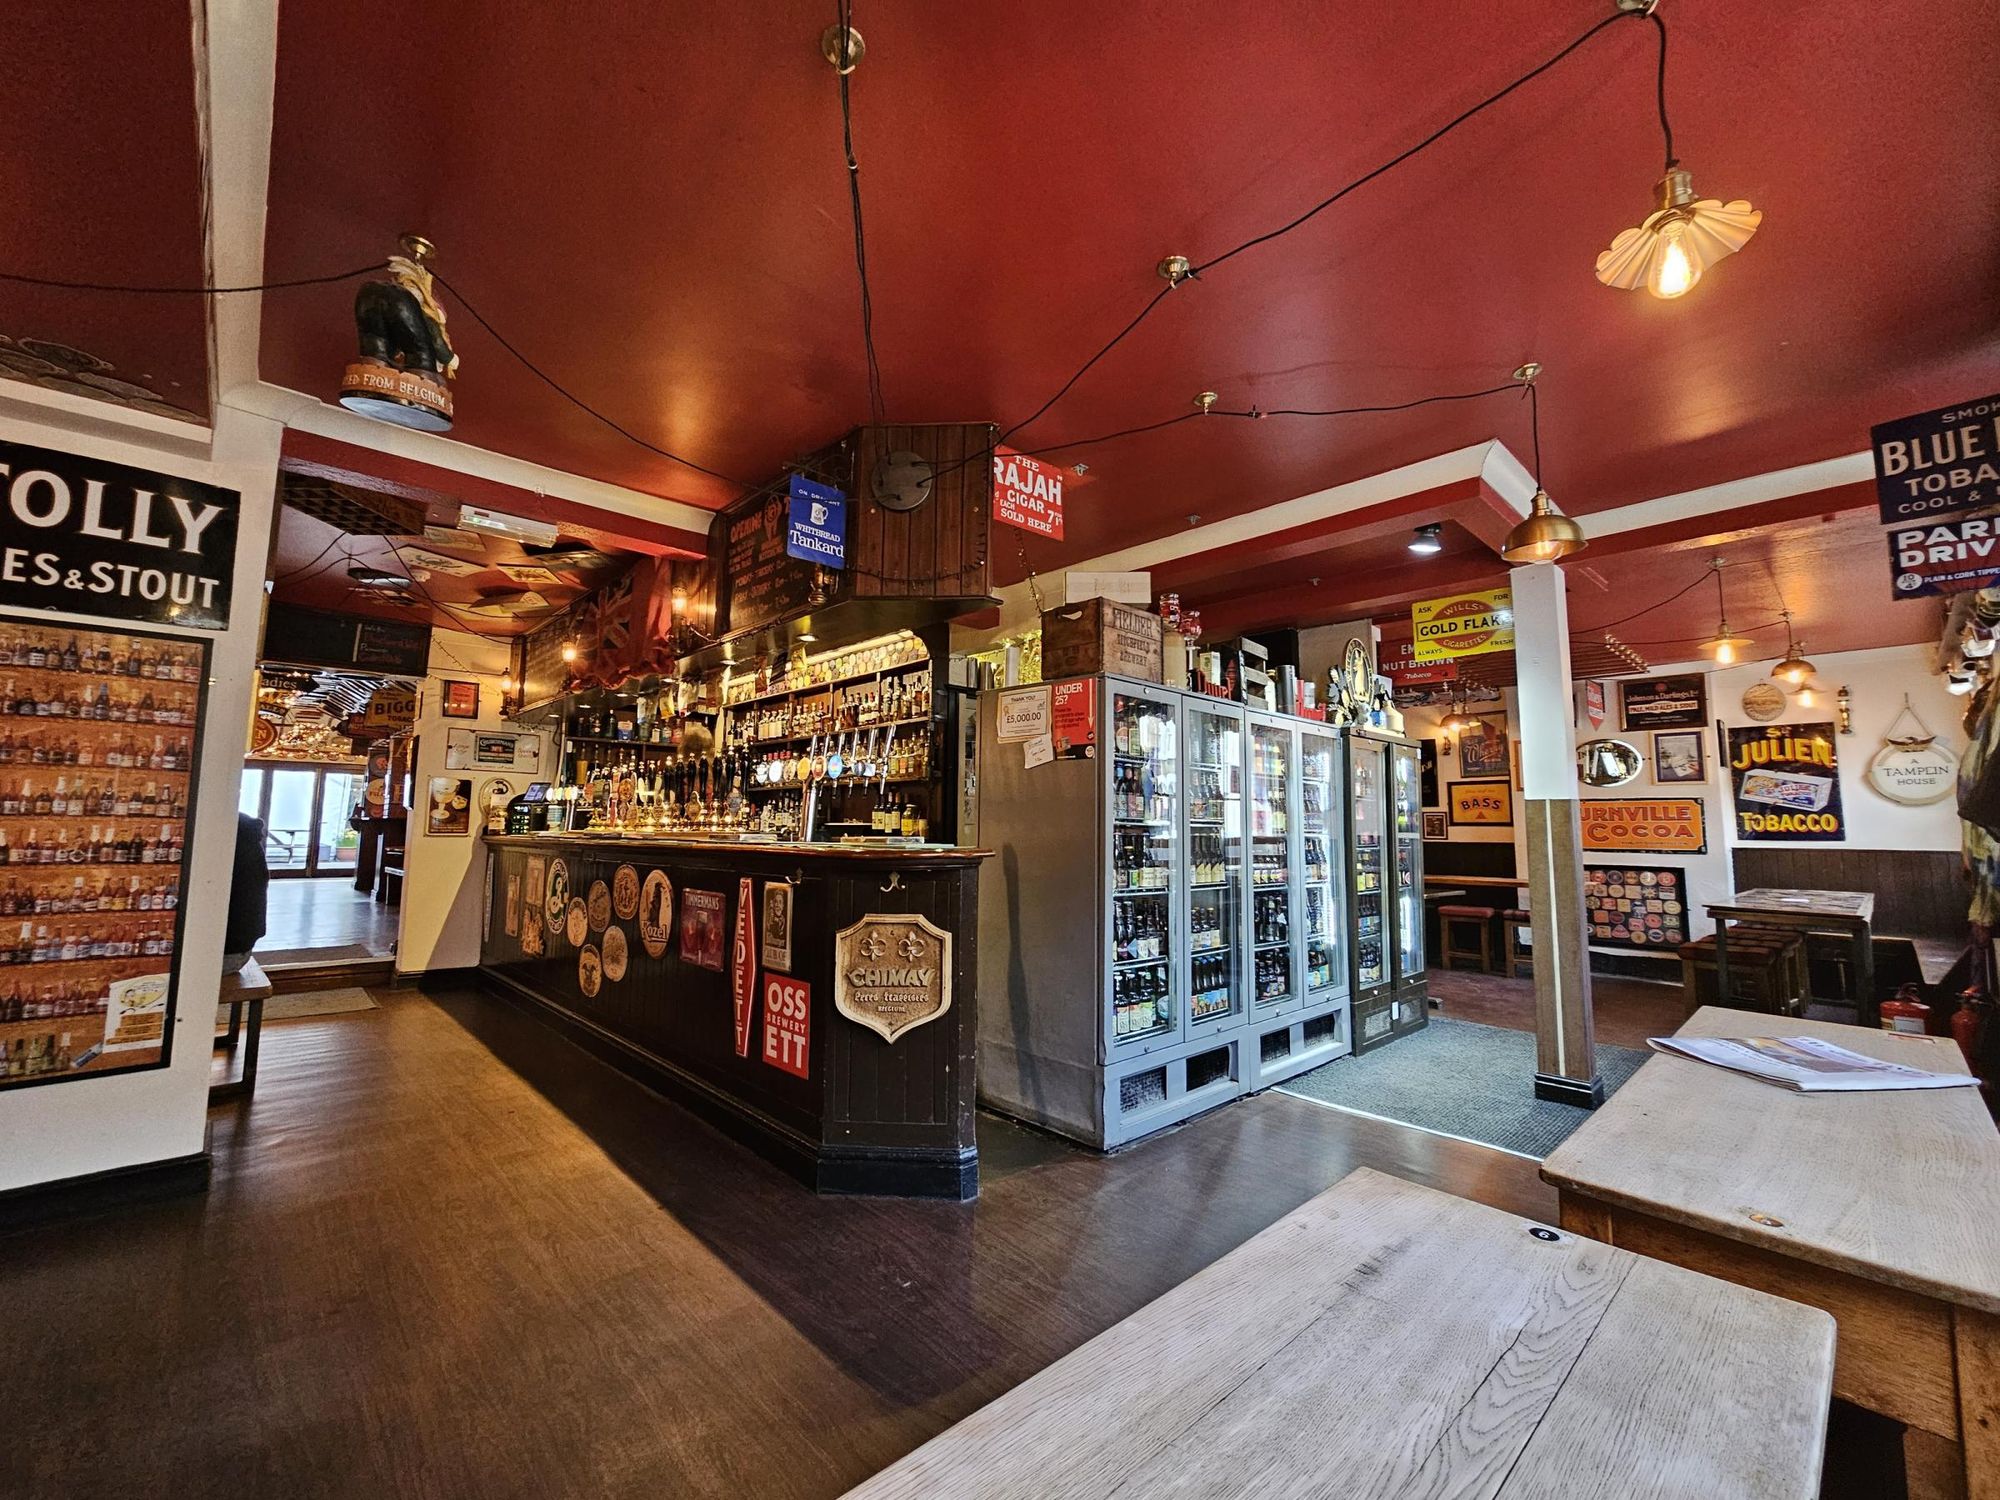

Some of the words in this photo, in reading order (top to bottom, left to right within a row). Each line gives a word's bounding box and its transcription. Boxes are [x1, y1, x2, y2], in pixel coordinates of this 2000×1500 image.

[363, 373, 395, 390] FROM
[399, 382, 446, 408] BELGIUM
[1881, 424, 1986, 477] BLUE
[1014, 455, 1040, 472] THE
[798, 488, 808, 496] ON
[1007, 489, 1045, 514] CIGAR
[1898, 496, 1959, 514] COOL
[1968, 490, 1982, 502] &
[1000, 507, 1025, 524] SOLD
[1027, 517, 1053, 533] HERE
[794, 522, 841, 543] WHITBREAD
[789, 529, 845, 559] Tankard
[1899, 537, 1996, 568] DRIV
[1924, 574, 1946, 583] PLAIN
[1954, 571, 1976, 579] CORK
[1417, 605, 1433, 614] ASK
[1493, 593, 1509, 601] FOR
[1420, 621, 1458, 637] GOLD
[1464, 614, 1513, 630] FLAK
[1417, 647, 1443, 656] ALWAYS
[1490, 639, 1514, 647] FRESH
[1443, 633, 1487, 648] CIGARETTES
[1382, 660, 1407, 672] NUT
[1408, 657, 1454, 669] BROWN
[262, 677, 297, 690] adies
[1403, 671, 1432, 680] Tobacco
[1055, 682, 1083, 696] UNDER
[1055, 694, 1069, 706] 25?
[1006, 711, 1042, 725] £5,000.00
[1732, 737, 1834, 770] JULIEN
[1882, 765, 1949, 777] TAMPLIN
[1896, 777, 1937, 786] HOUSE
[1460, 797, 1501, 811] BASS
[1587, 822, 1695, 842] COCOA
[1739, 812, 1839, 833] TOBACCO
[641, 920, 668, 939] Kozel
[735, 887, 749, 1046] VEDETT
[846, 967, 936, 988] CHIMAY
[767, 982, 807, 1021] OSS
[766, 1012, 806, 1035] BREWERY
[766, 1024, 806, 1069] ETT
